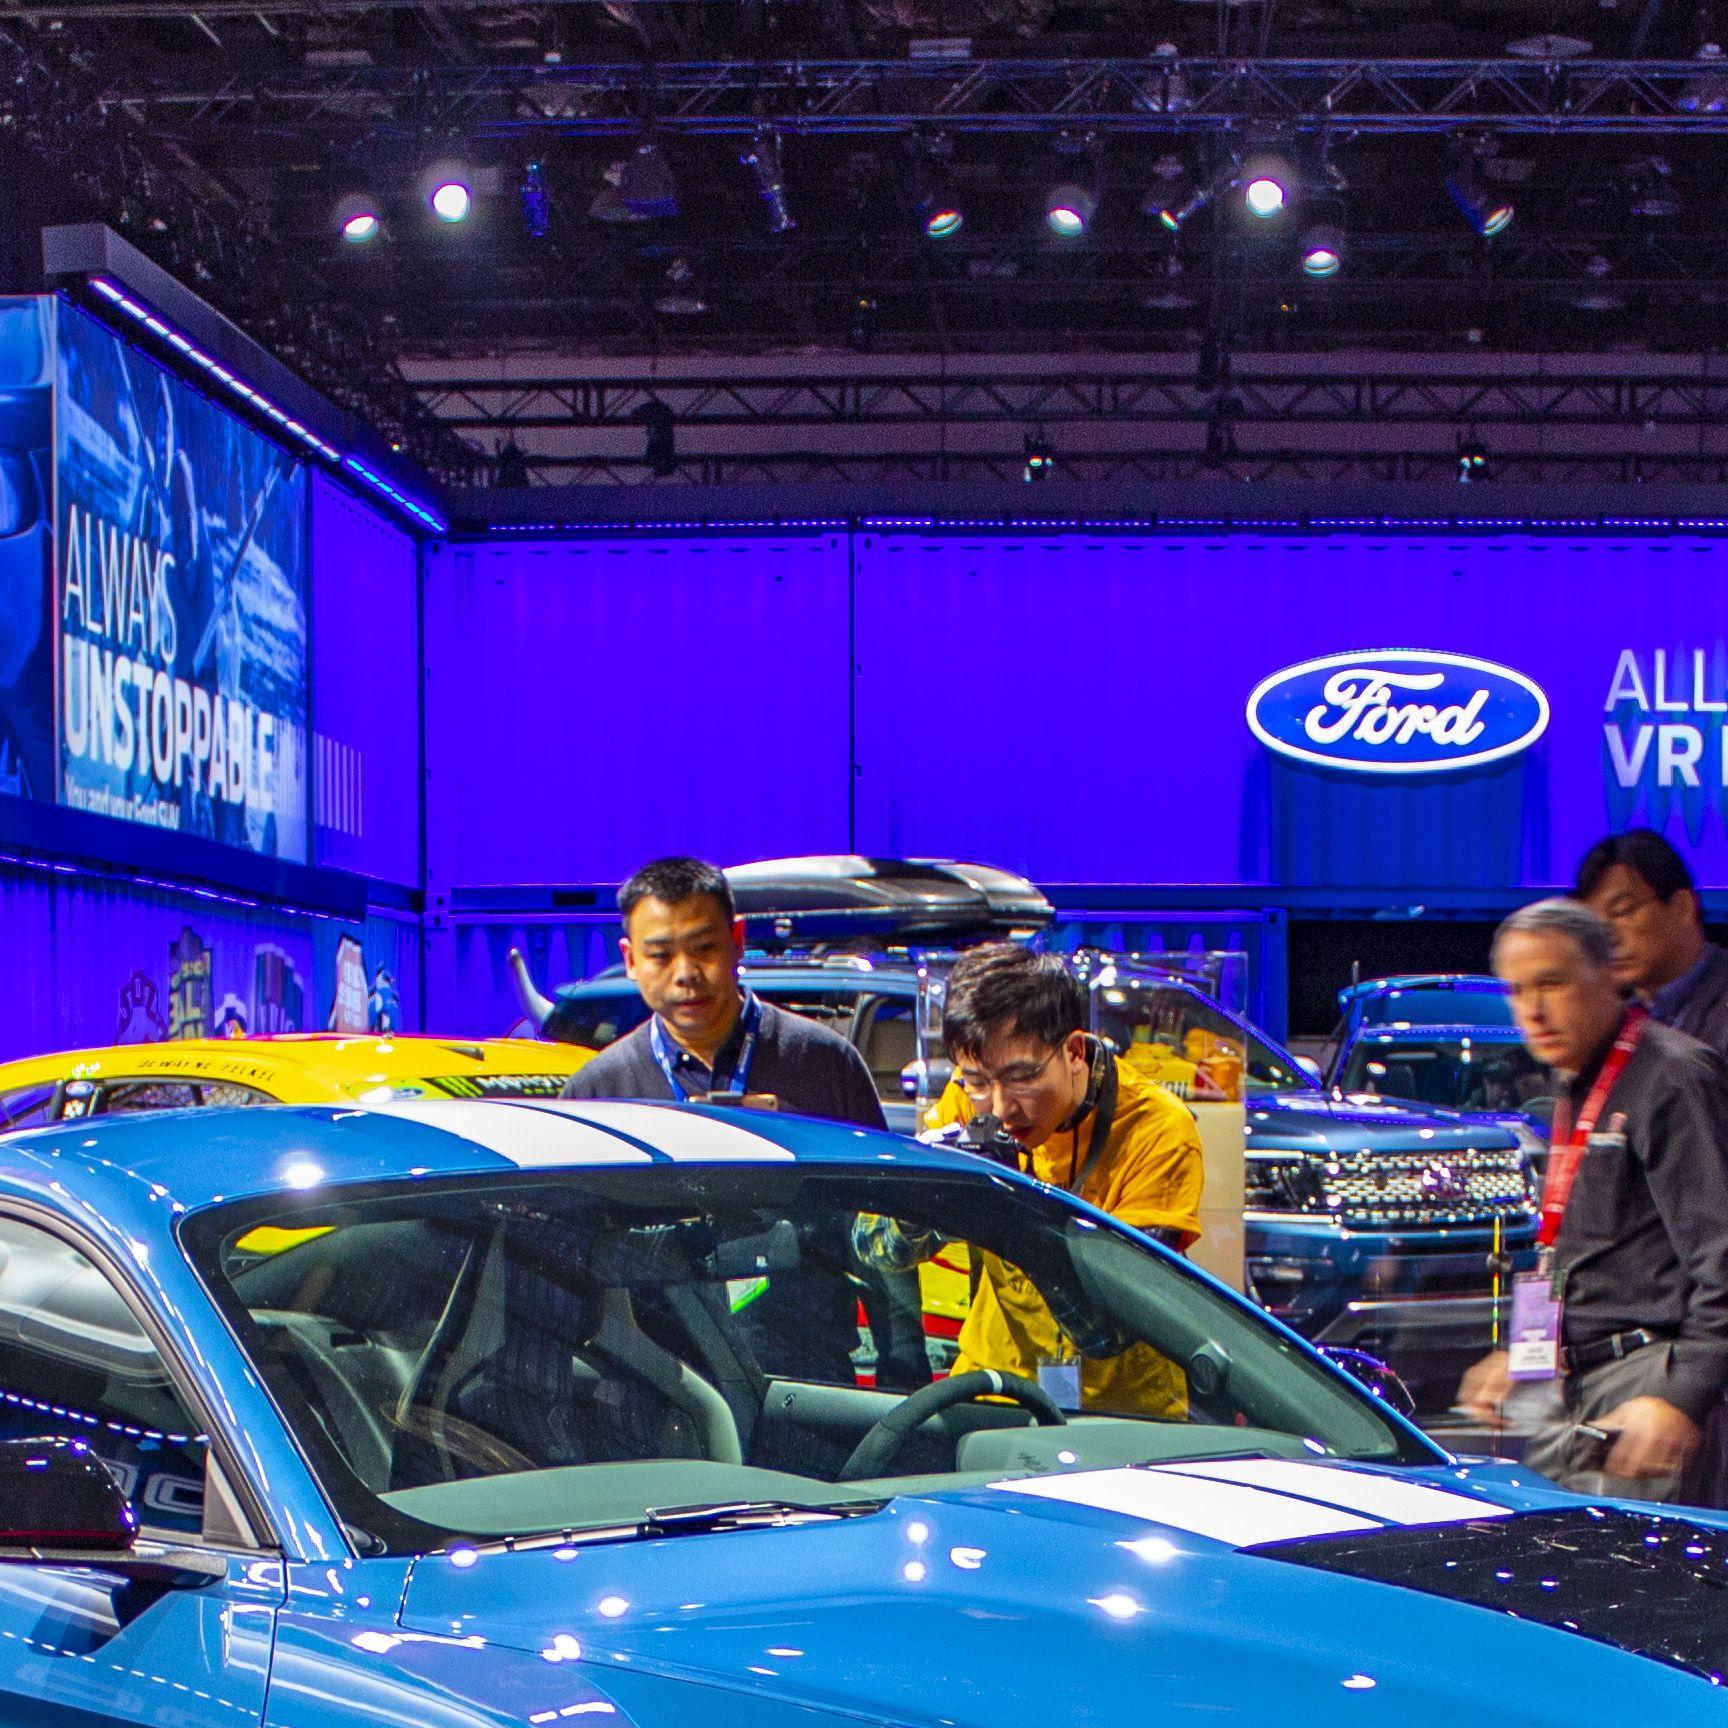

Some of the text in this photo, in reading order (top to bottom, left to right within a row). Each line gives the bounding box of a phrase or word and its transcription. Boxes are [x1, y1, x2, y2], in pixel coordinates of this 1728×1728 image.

[63, 503, 178, 664] ALWAYS
[63, 632, 275, 813] UNSTOPPABLE
[1302, 667, 1486, 749] Ford
[1604, 725, 1703, 790] VR
